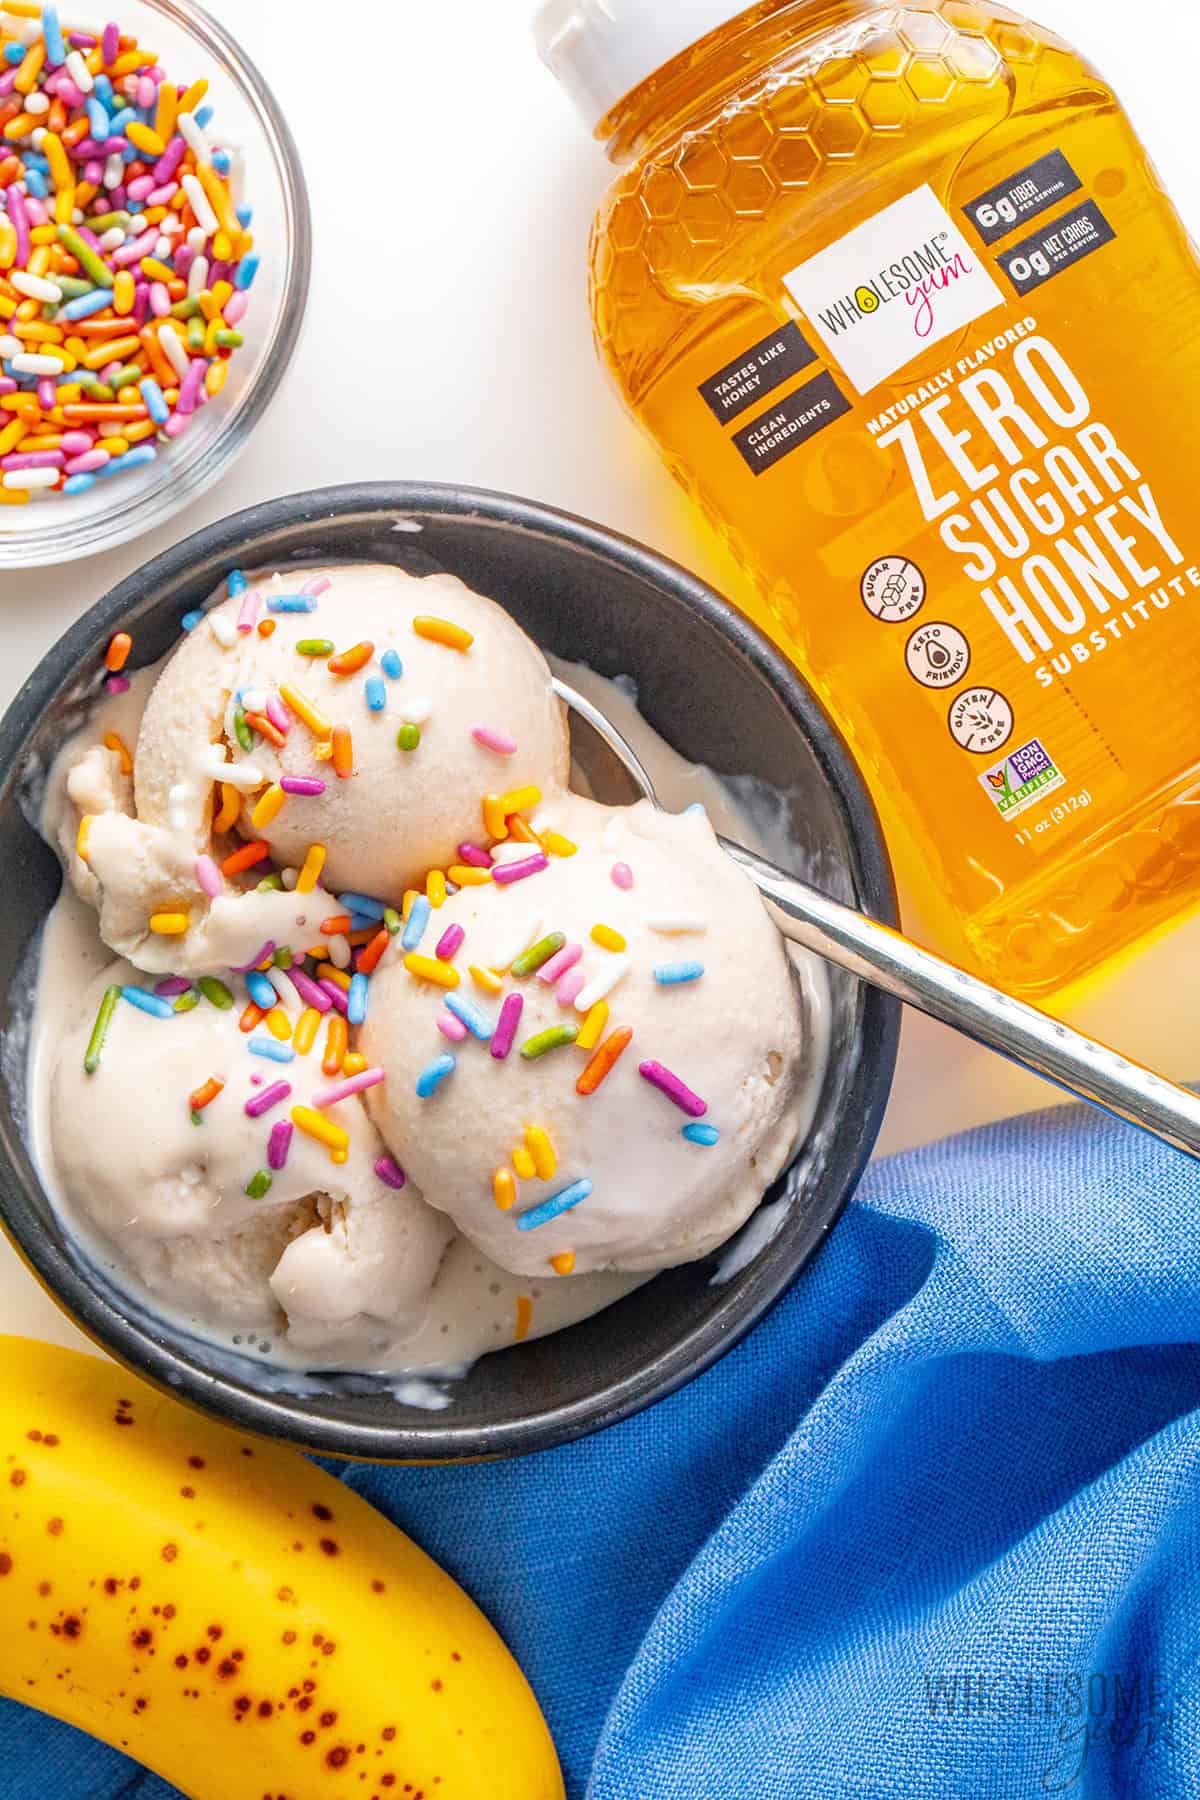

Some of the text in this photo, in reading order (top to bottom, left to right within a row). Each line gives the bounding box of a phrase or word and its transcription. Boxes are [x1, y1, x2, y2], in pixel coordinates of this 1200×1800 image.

[975, 179, 1040, 228] 6g FIBER
[1009, 216, 1095, 281] 0g NET CARBS
[1053, 231, 1099, 263] PER SERVING
[905, 253, 973, 337] yum
[714, 342, 787, 397] TASTES LIKE
[865, 316, 1037, 435] NATURALLY FLAVORED
[721, 374, 762, 409] HONEY
[747, 413, 787, 446] CLEAN
[754, 399, 831, 457] INGREDIENTS
[876, 334, 1091, 523] ZERO
[939, 421, 1142, 582] SUGAR
[865, 562, 891, 598] SUGAR
[981, 483, 1185, 664] HONEY
[898, 585, 920, 615] FREE
[912, 628, 941, 653] KETO
[1035, 566, 1200, 688] SUBSTITUTE
[925, 649, 965, 681] FRIENDLY
[954, 694, 988, 728] GLUTEN
[980, 720, 1005, 746] FREE
[1011, 743, 1039, 766] NON
[1017, 751, 1045, 773] GMO
[1021, 760, 1050, 780] Project
[999, 769, 1056, 809] VERIFIED
[1015, 828, 1032, 846] 11
[1035, 820, 1051, 833] oz
[1050, 789, 1093, 824] (312g)
